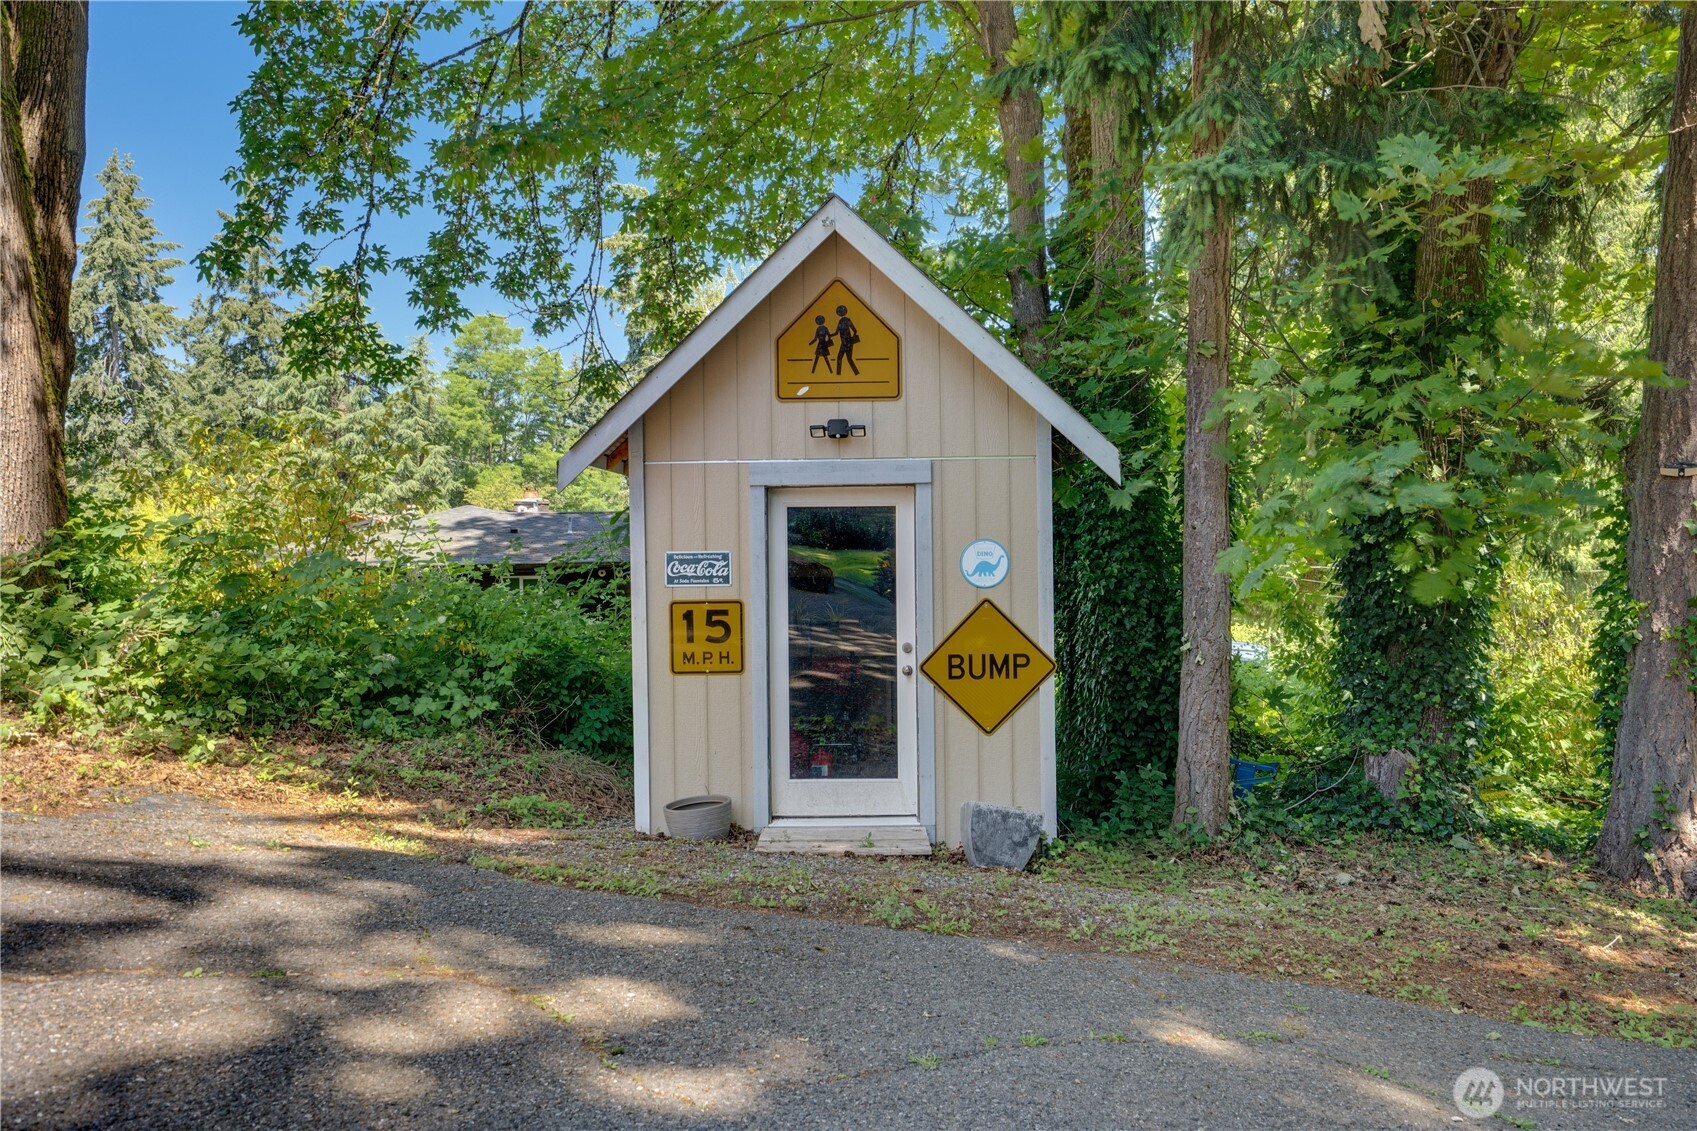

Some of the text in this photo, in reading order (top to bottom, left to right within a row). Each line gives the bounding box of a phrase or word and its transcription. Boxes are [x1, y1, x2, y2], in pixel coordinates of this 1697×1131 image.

[682, 609, 731, 643] 15
[683, 651, 734, 664] M.P.H.
[948, 654, 1031, 680] BUMP
